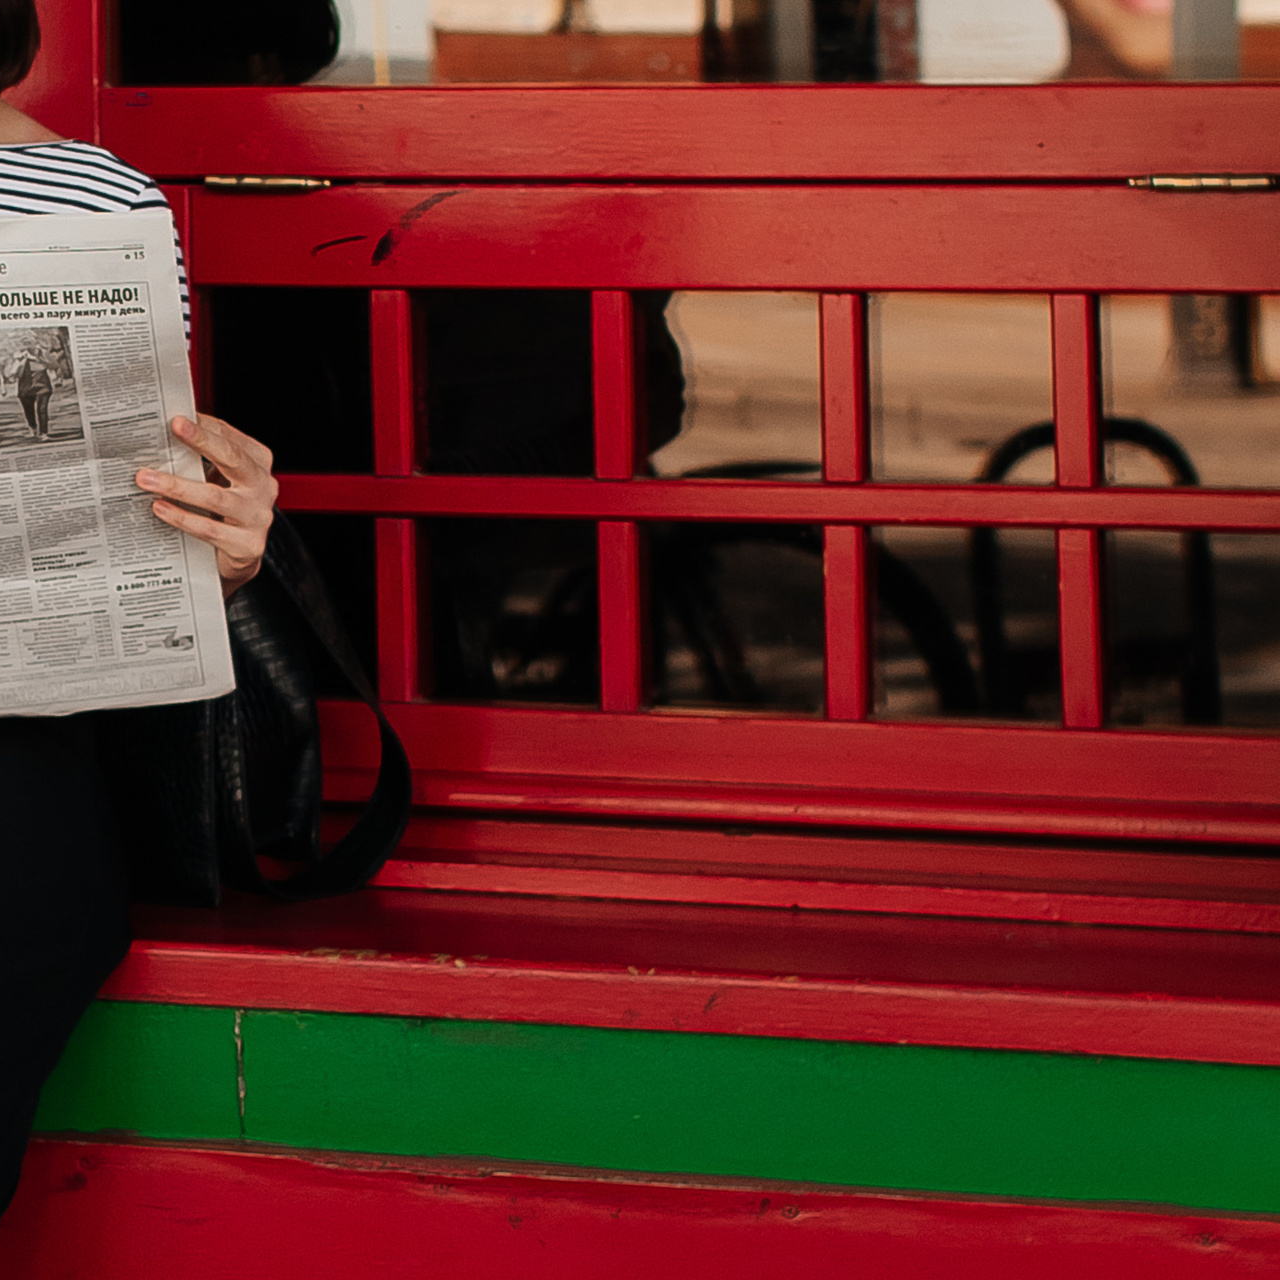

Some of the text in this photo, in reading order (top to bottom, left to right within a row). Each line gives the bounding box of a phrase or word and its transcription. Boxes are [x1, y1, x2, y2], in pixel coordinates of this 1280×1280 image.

[133, 251, 146, 260] 15
[63, 289, 84, 305] НЕ
[88, 287, 139, 305] НАДО!
[1, 310, 30, 321] всего
[32, 311, 45, 319] за
[47, 309, 72, 320] пару
[74, 308, 107, 319] минут
[110, 308, 117, 316] в
[119, 306, 146, 317] день
